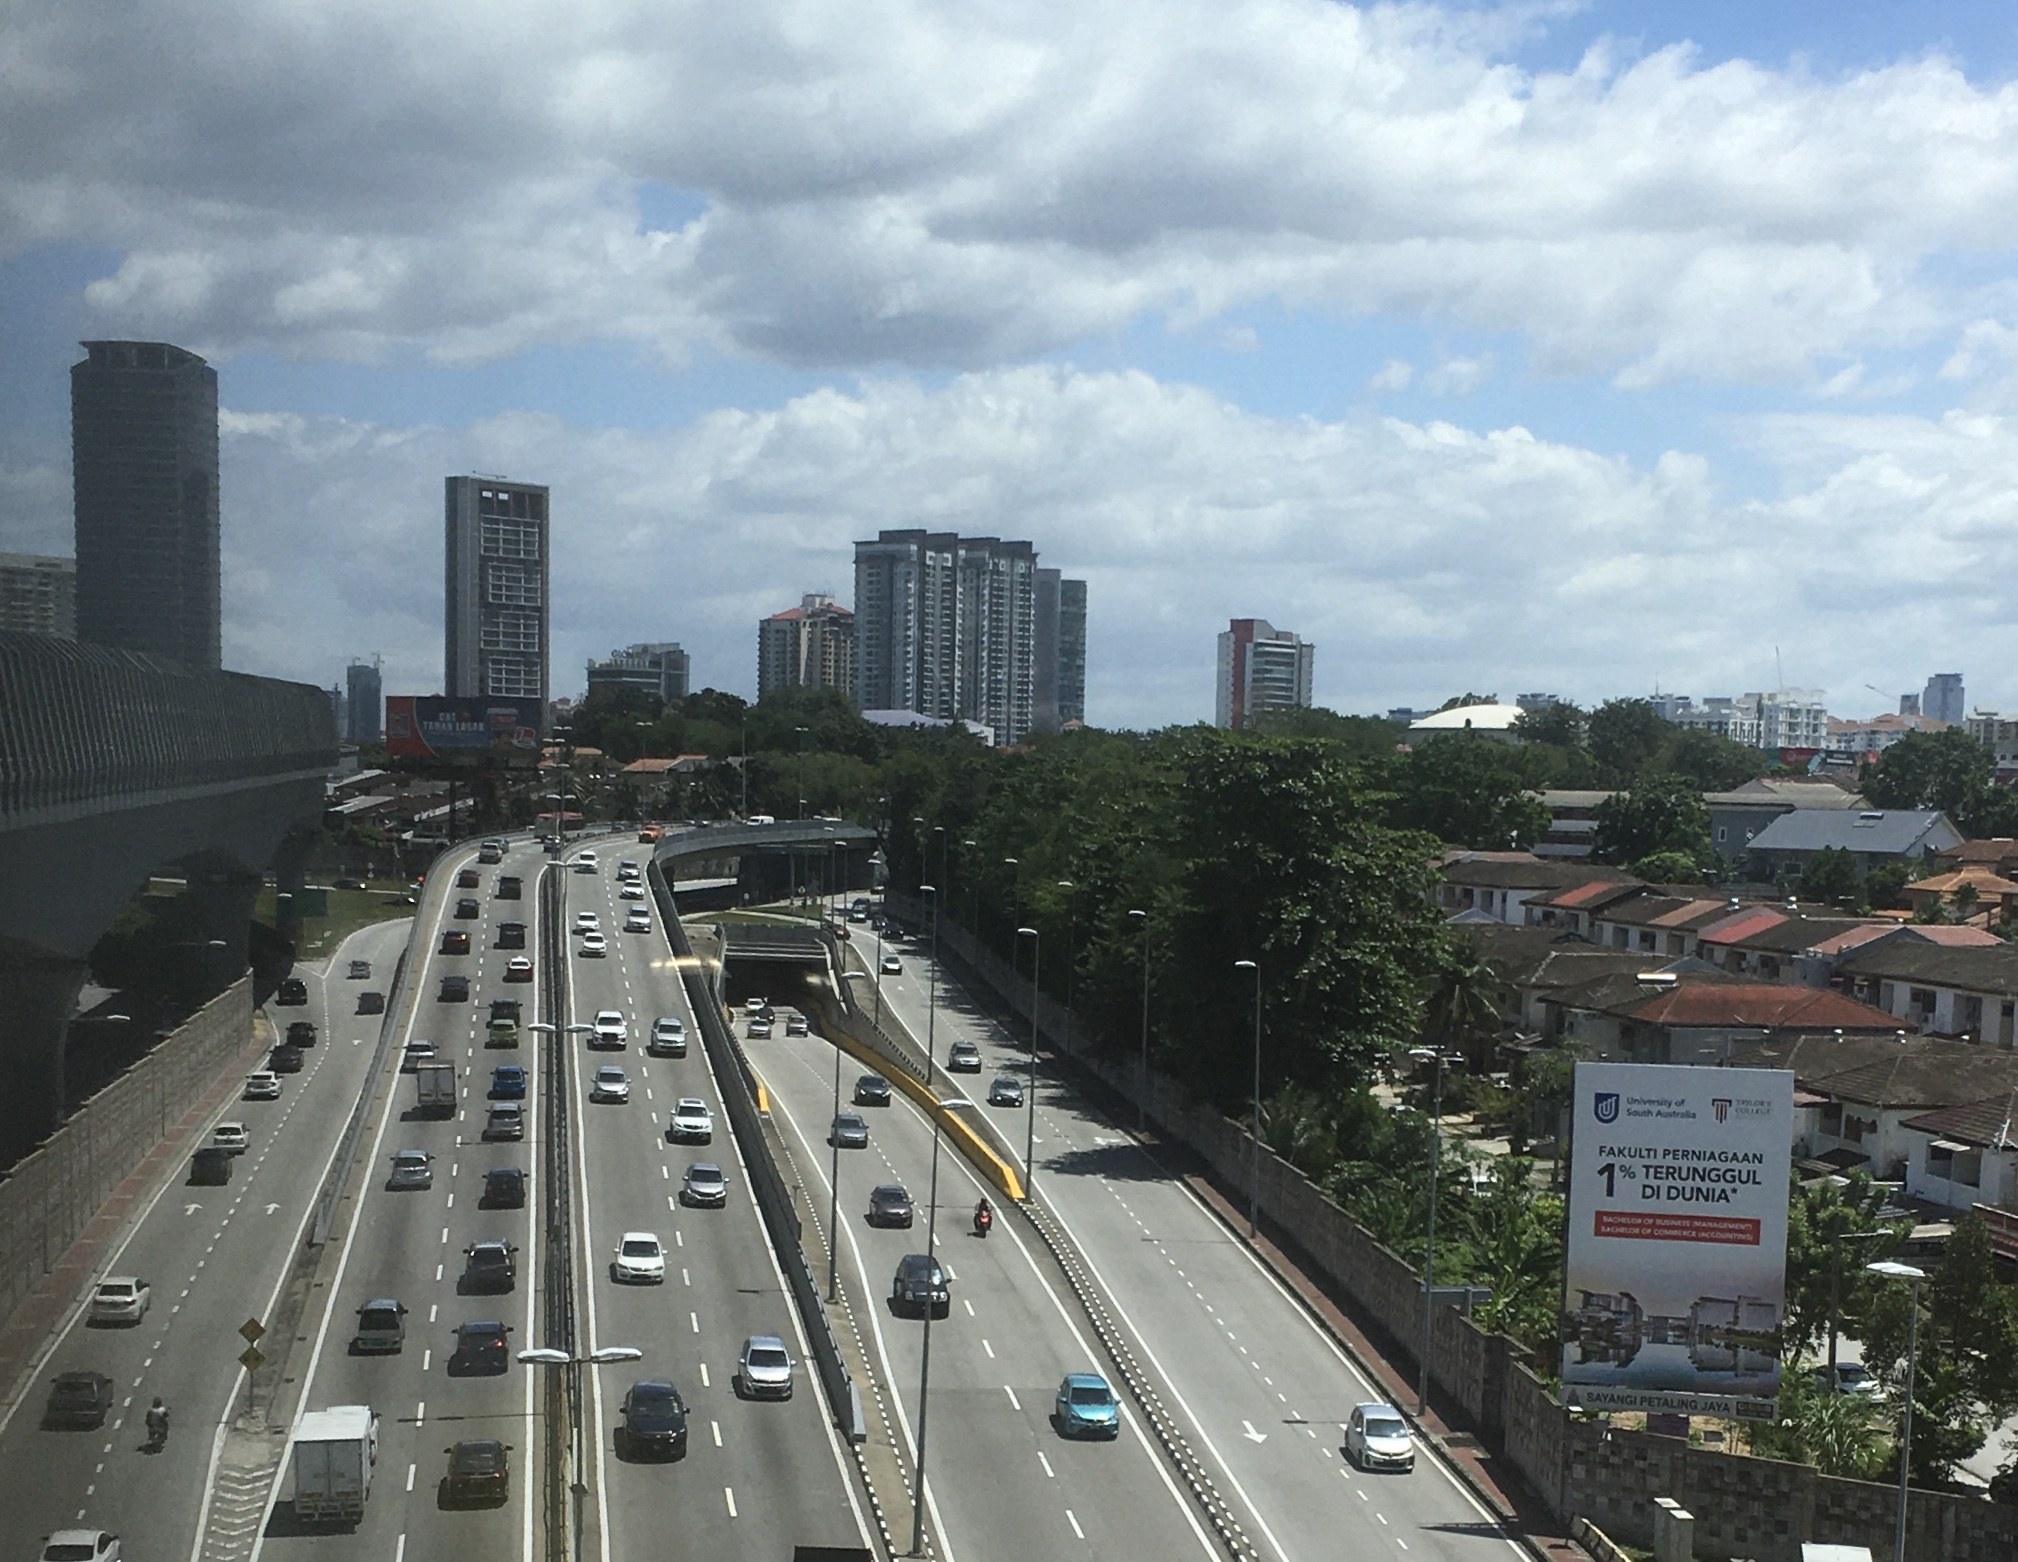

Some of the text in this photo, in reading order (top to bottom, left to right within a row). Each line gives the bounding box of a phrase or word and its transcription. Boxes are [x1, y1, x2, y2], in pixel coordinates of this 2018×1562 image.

[1626, 1096, 1686, 1109] University of
[1626, 1108, 1697, 1120] South Australia
[1599, 1146, 1763, 1164] FAKULTI PERNIAGAAN
[1597, 1162, 1762, 1198] 1% TERUNGGUL
[1641, 1184, 1661, 1200] DI
[1602, 1215, 1642, 1225] BACHELOR
[1655, 1218, 1690, 1227] BUSINESS
[1600, 1225, 1640, 1234] BACHELOR
[1653, 1228, 1697, 1238] COMMERCE
[1586, 1392, 1637, 1406] SAYANGI
[1640, 1396, 1698, 1411] PETALING
[1700, 1399, 1730, 1413] JAYA
